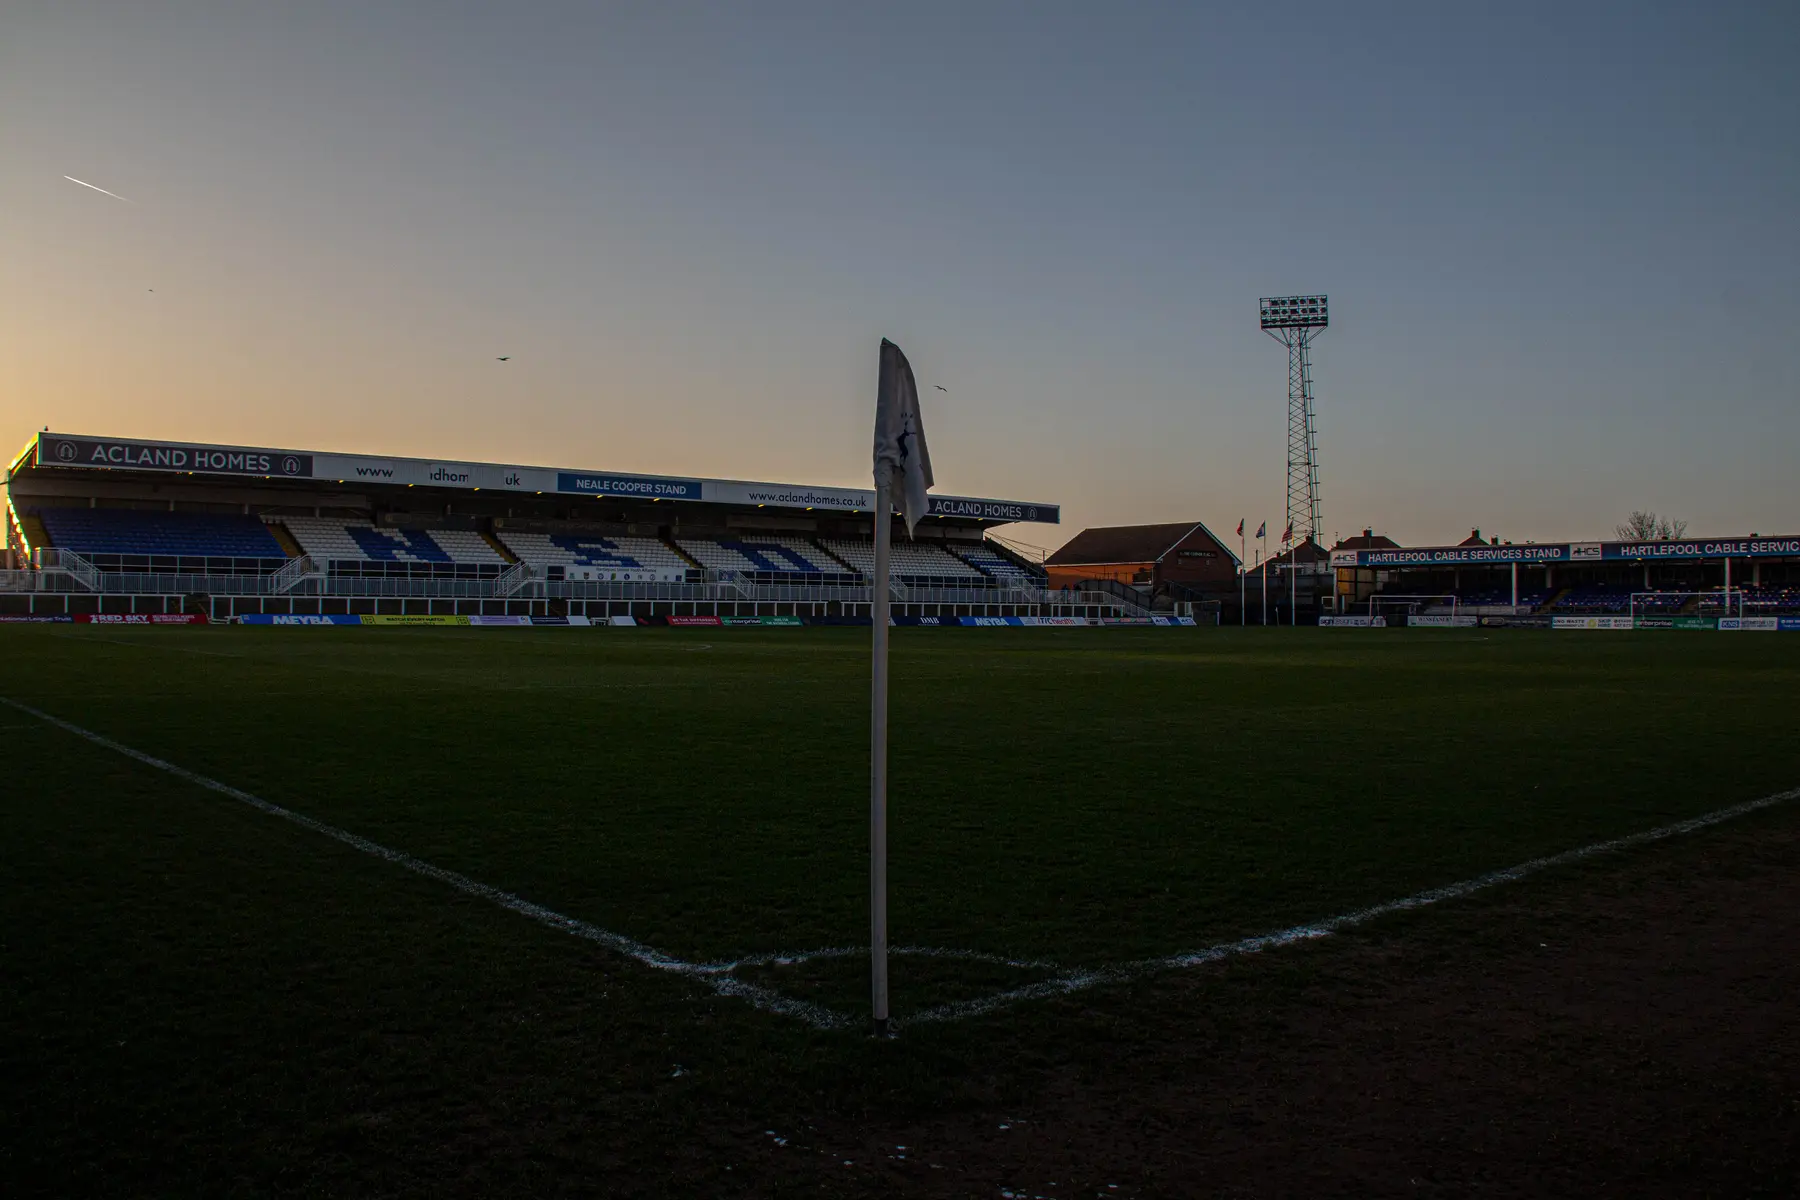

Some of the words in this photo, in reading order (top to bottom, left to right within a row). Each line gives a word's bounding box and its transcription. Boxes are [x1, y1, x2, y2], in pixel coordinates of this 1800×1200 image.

[91, 444, 188, 467] ACLAND
[195, 452, 271, 472] HOMES
[505, 473, 520, 485] uk
[576, 479, 610, 491] NEALE
[612, 481, 652, 493] COOPER
[654, 484, 687, 495] STAND
[749, 492, 867, 507] www.aclandhomes.co.uk
[935, 501, 982, 515] ACLAND
[984, 505, 1022, 518] HOMES
[1368, 552, 1433, 563] HARTLEPOOL
[1434, 551, 1468, 561] CABLE
[1470, 549, 1521, 560] SERVICES
[1524, 548, 1562, 559] STAND
[1621, 544, 1703, 556] HARTLEPOOL
[1705, 542, 1748, 554] CABLE
[1750, 541, 1800, 552] SERVIC
[99, 614, 123, 622] RED
[125, 614, 148, 622] SKY
[272, 615, 335, 625] MEYBA
[974, 617, 1009, 626] MEYBA
